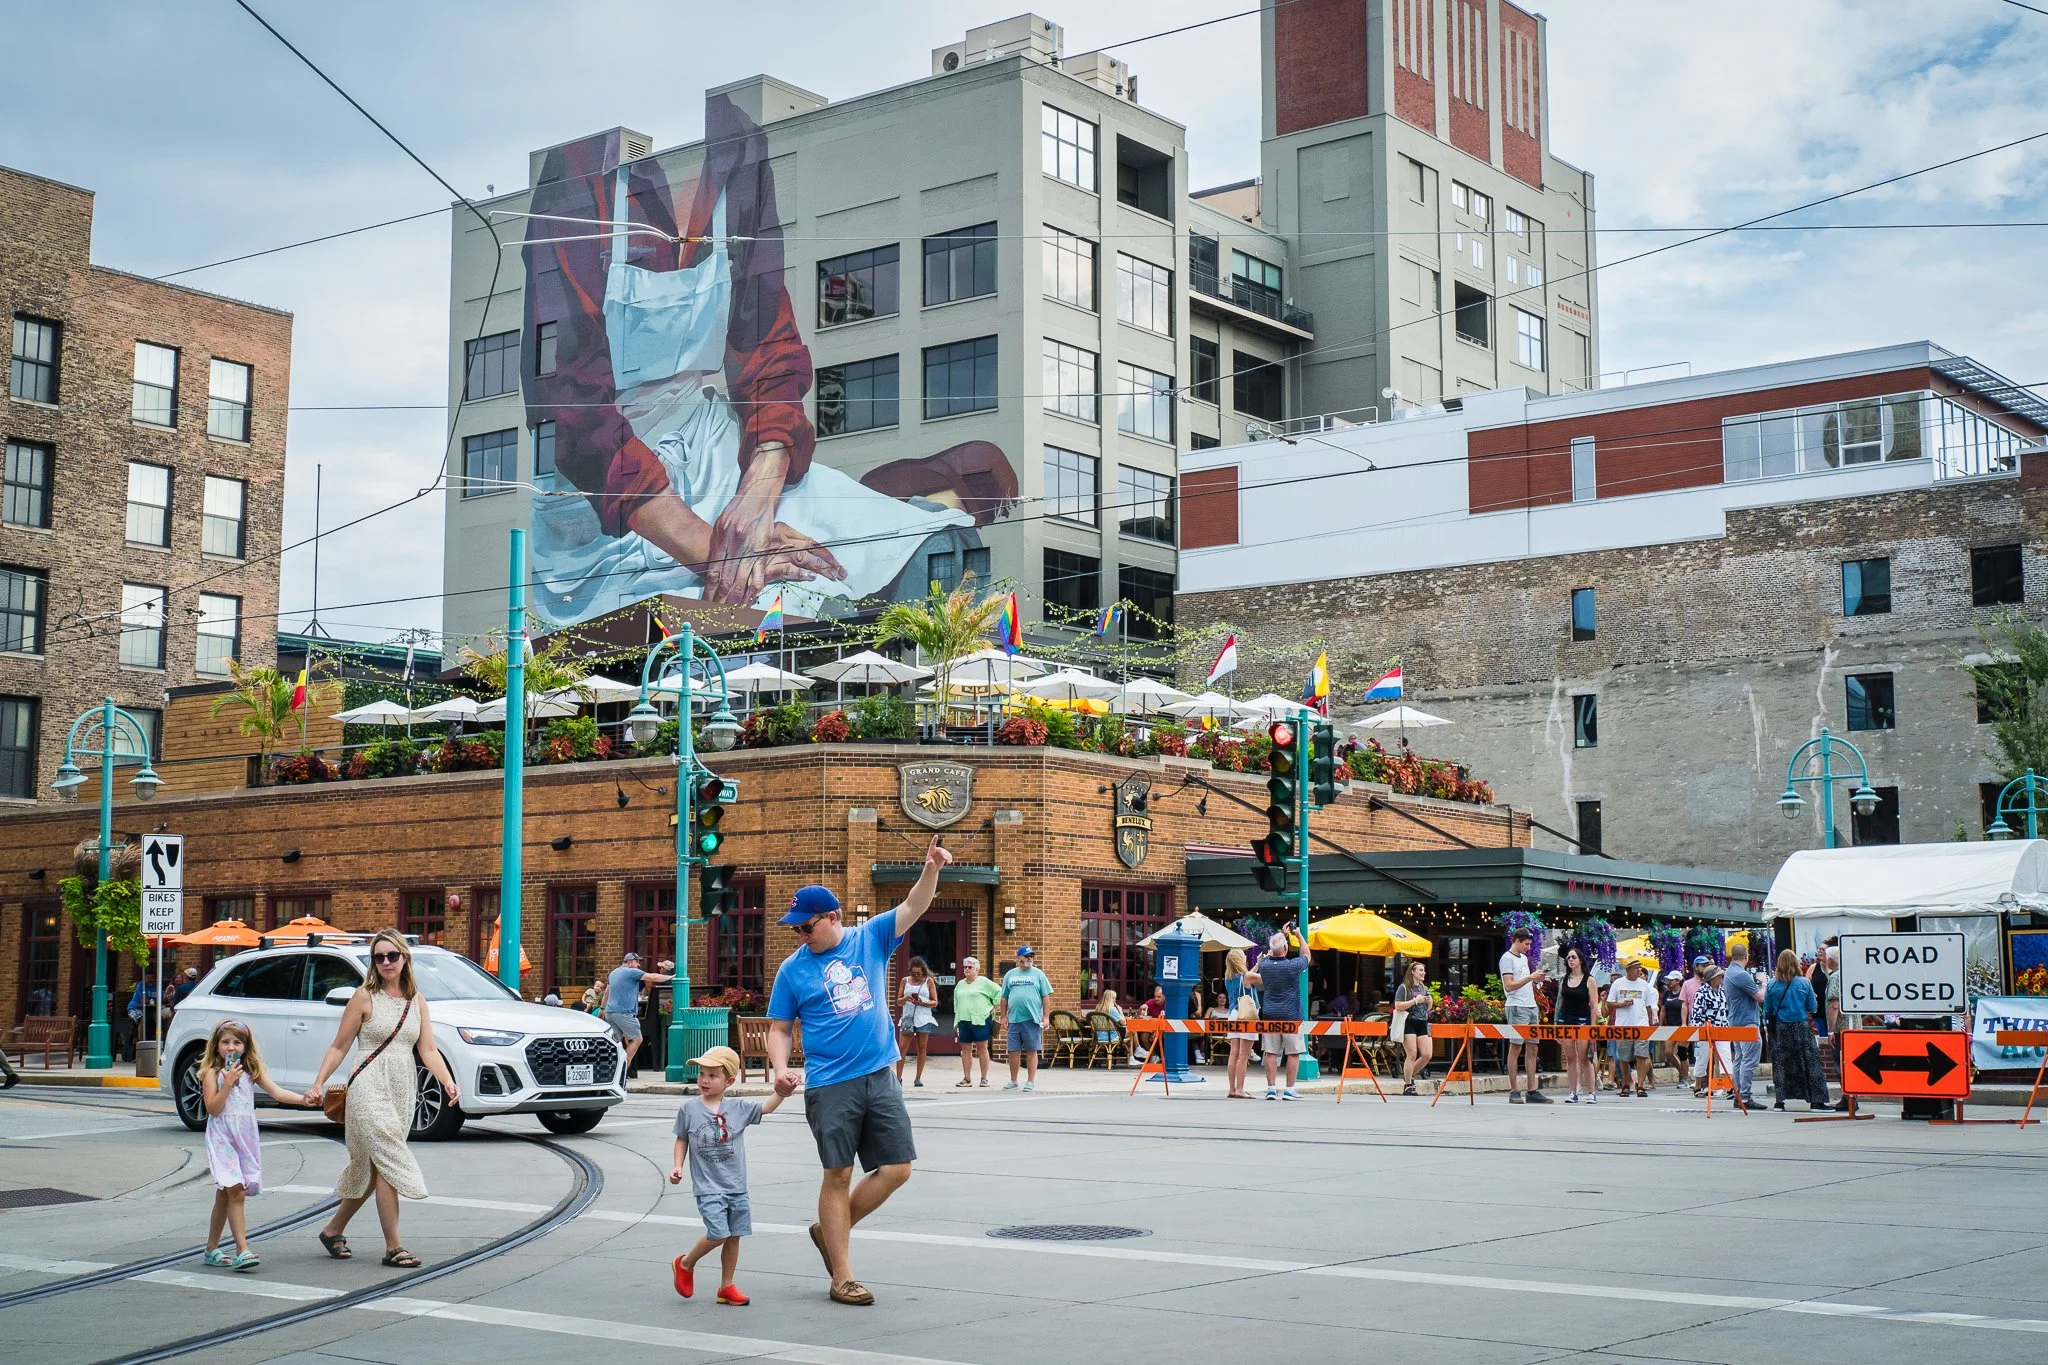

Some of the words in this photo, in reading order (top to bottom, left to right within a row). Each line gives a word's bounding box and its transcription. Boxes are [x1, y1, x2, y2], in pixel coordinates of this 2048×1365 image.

[909, 767, 940, 776] GRAND
[1121, 816, 1146, 827] BENELUX
[148, 893, 176, 903] BIKES
[149, 907, 174, 917] KEEP
[147, 921, 176, 931] RIGHT
[1090, 942, 1096, 953] A
[1865, 946, 1938, 965] ROAD
[1850, 982, 1955, 1001] CLOSED
[1208, 1021, 1250, 1033] STREET
[1255, 1021, 1297, 1034] CLOSED
[1529, 1026, 1581, 1039] STREET
[1589, 1026, 1641, 1040] CLOSED
